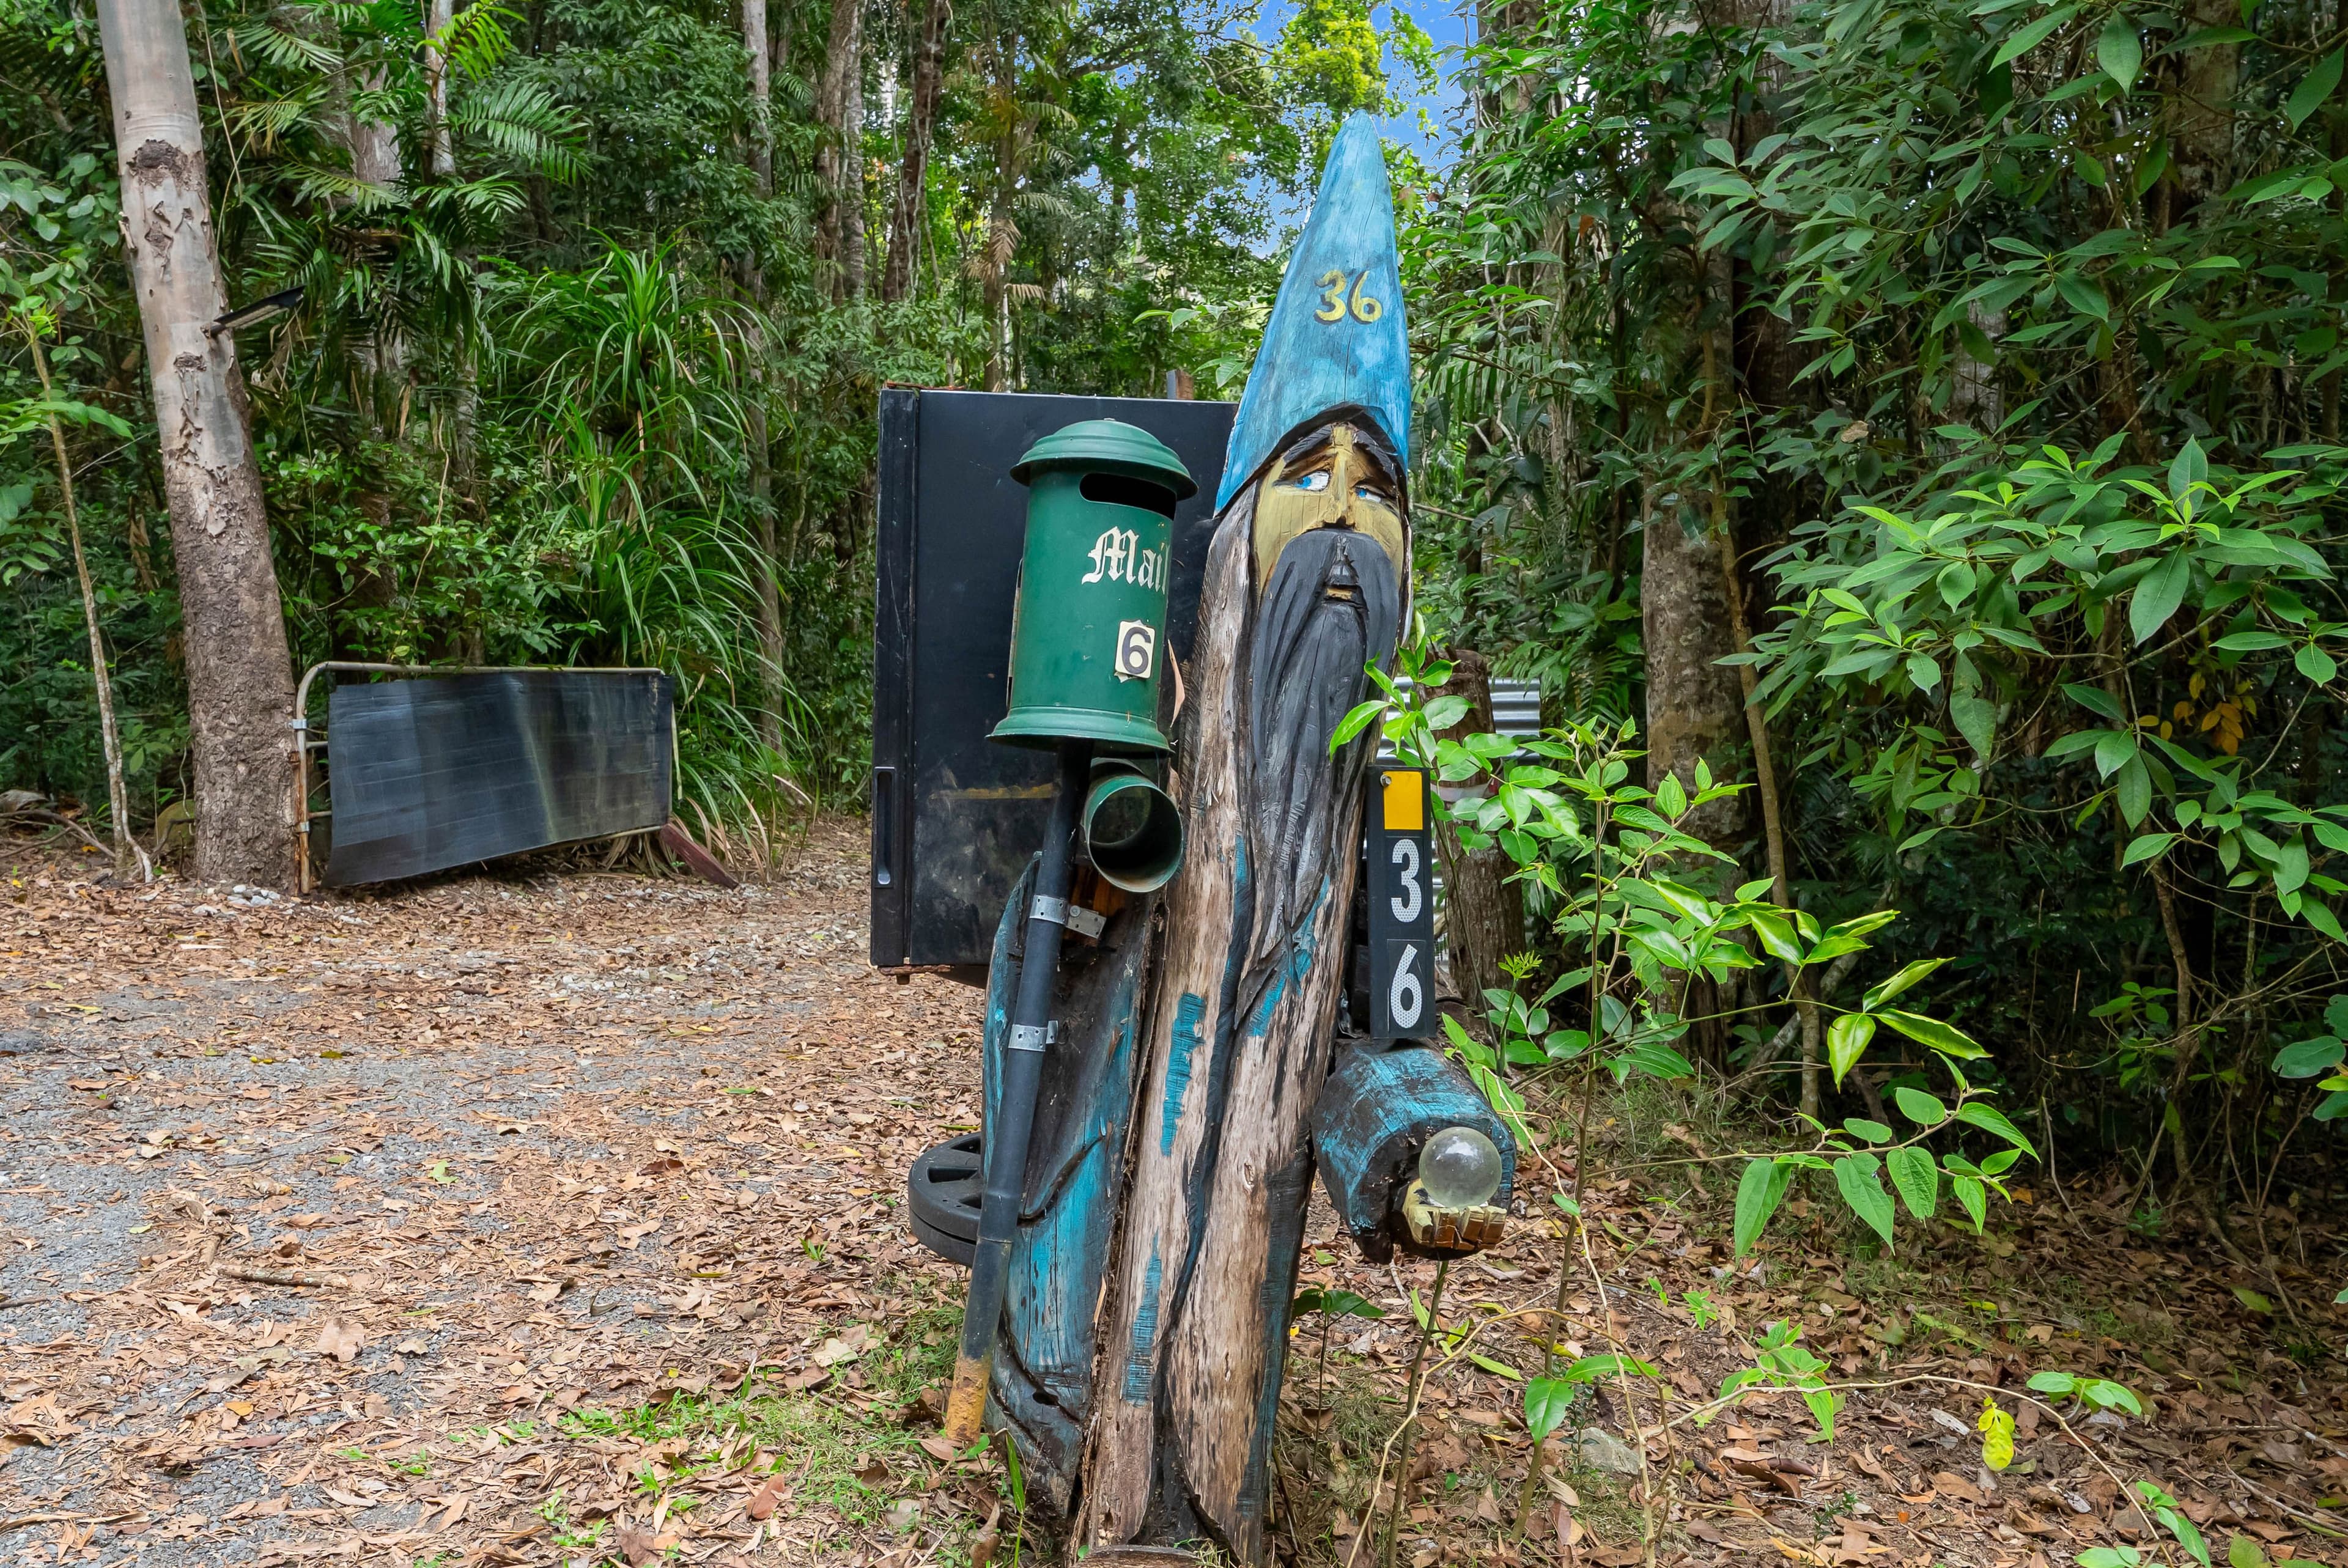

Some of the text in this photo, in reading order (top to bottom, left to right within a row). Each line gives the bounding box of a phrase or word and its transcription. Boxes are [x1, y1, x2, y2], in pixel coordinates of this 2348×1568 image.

[1313, 269, 1383, 325] 36
[1082, 526, 1170, 595] Mail
[1121, 626, 1151, 675] 6
